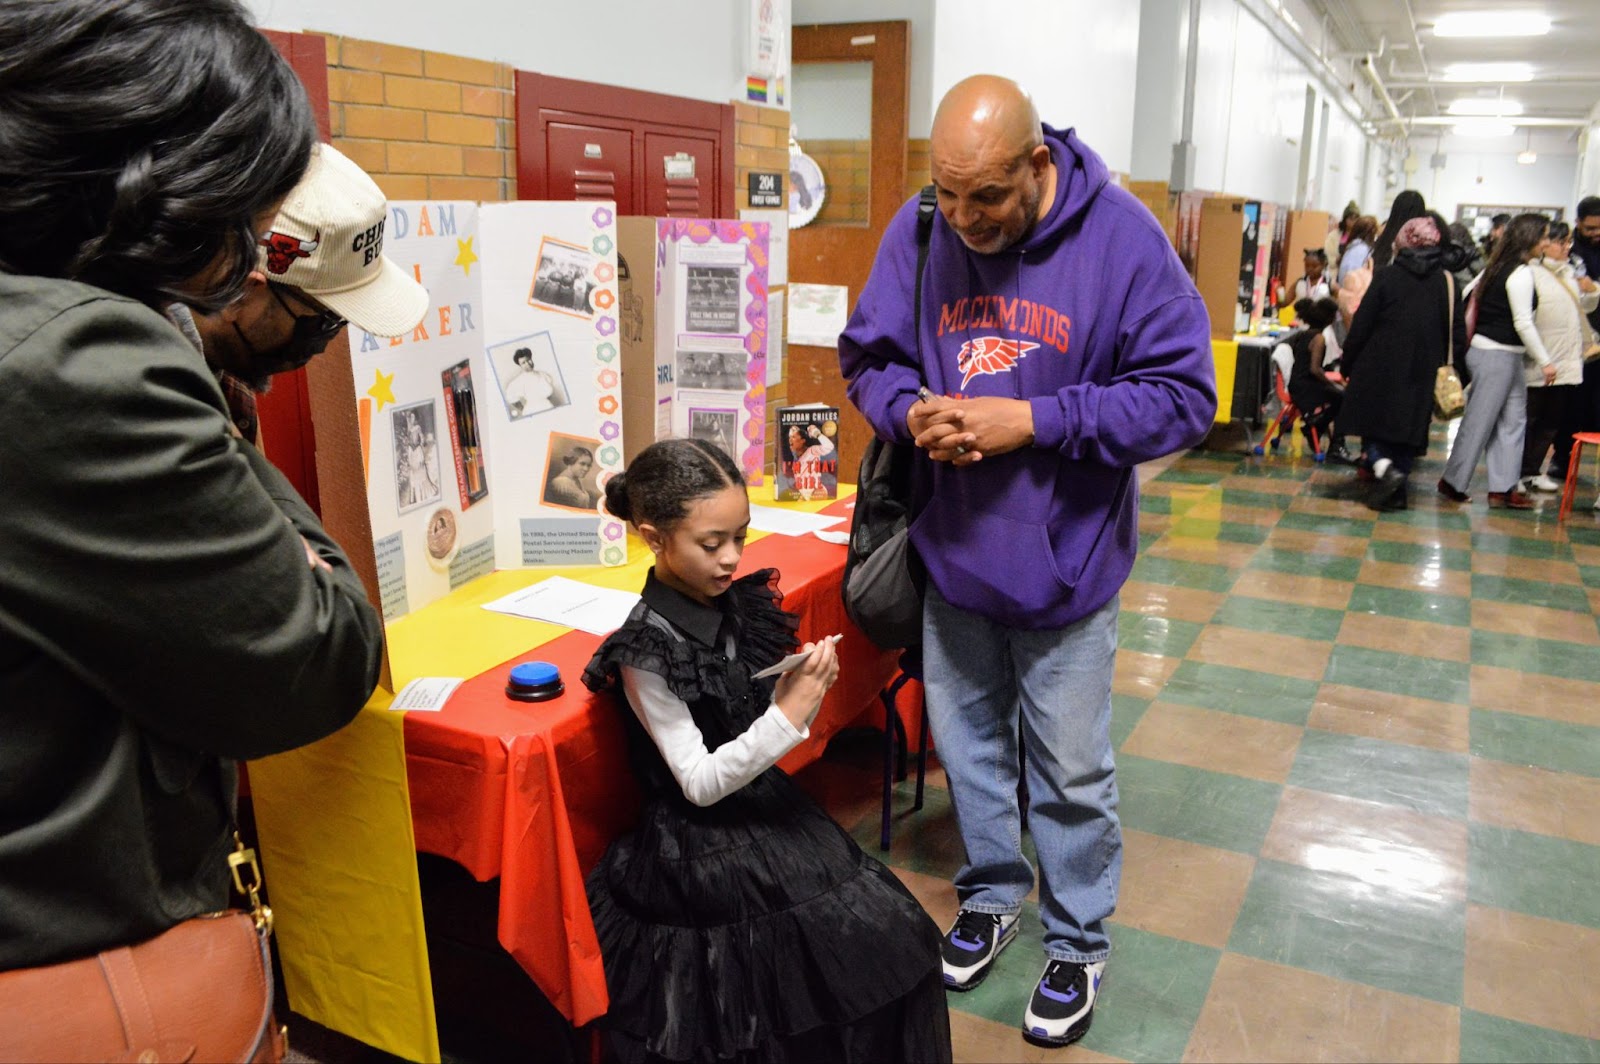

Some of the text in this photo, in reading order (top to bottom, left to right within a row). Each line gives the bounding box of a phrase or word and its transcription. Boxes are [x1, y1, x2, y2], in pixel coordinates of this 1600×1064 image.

[759, 175, 774, 190] 204
[782, 412, 838, 422] JORDAN CHILES
[807, 460, 837, 473] THAT
